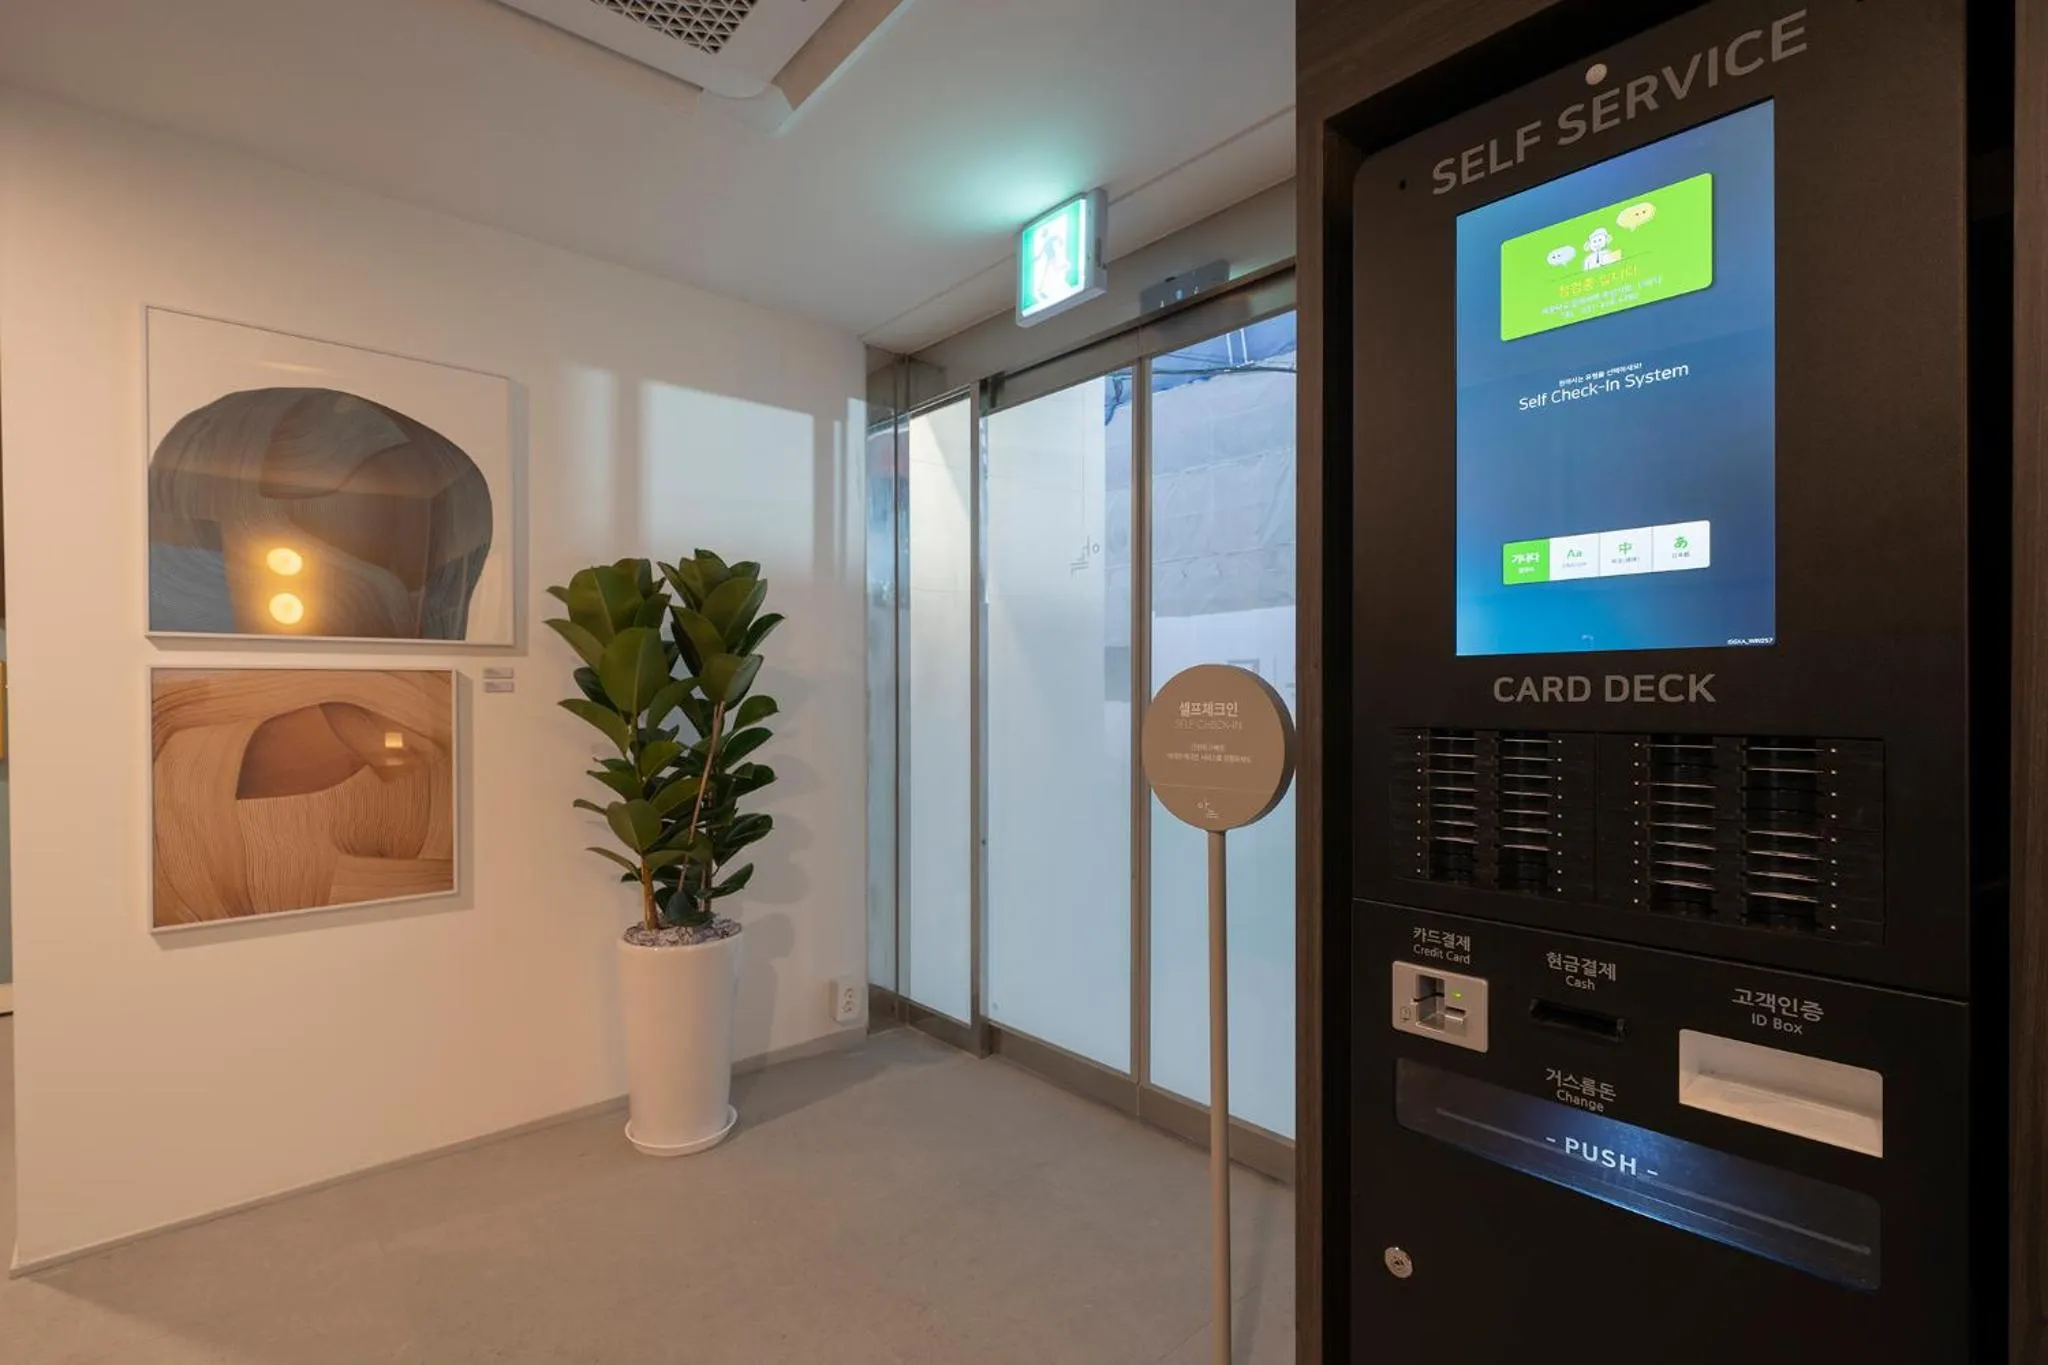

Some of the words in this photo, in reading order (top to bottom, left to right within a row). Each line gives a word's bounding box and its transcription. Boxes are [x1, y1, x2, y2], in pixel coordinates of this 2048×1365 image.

[1432, 120, 1542, 196] SELF
[1557, 9, 1808, 146] SERVICE
[1519, 393, 1548, 411] Self
[1551, 379, 1620, 404] Check-In
[1624, 364, 1689, 388] System
[1566, 549, 1582, 559] Aa
[1618, 541, 1632, 556] 中
[1674, 536, 1688, 549] あ
[1493, 675, 1592, 703] CARD
[1604, 673, 1717, 703] DECK
[1179, 701, 1239, 717] 셀프체크인
[1413, 927, 1470, 952] 카드결제
[1413, 944, 1444, 960] Credit
[1446, 950, 1470, 965] Card
[1546, 952, 1616, 982] 현금결제
[1565, 975, 1595, 991] Cash
[1731, 988, 1825, 1022] 고객인증
[1751, 1012, 1768, 1027] ID
[1773, 1017, 1804, 1035] Box
[1546, 1068, 1617, 1103] 거스름돈
[1556, 1089, 1604, 1113] Change
[1565, 1136, 1637, 1176] PUSH
